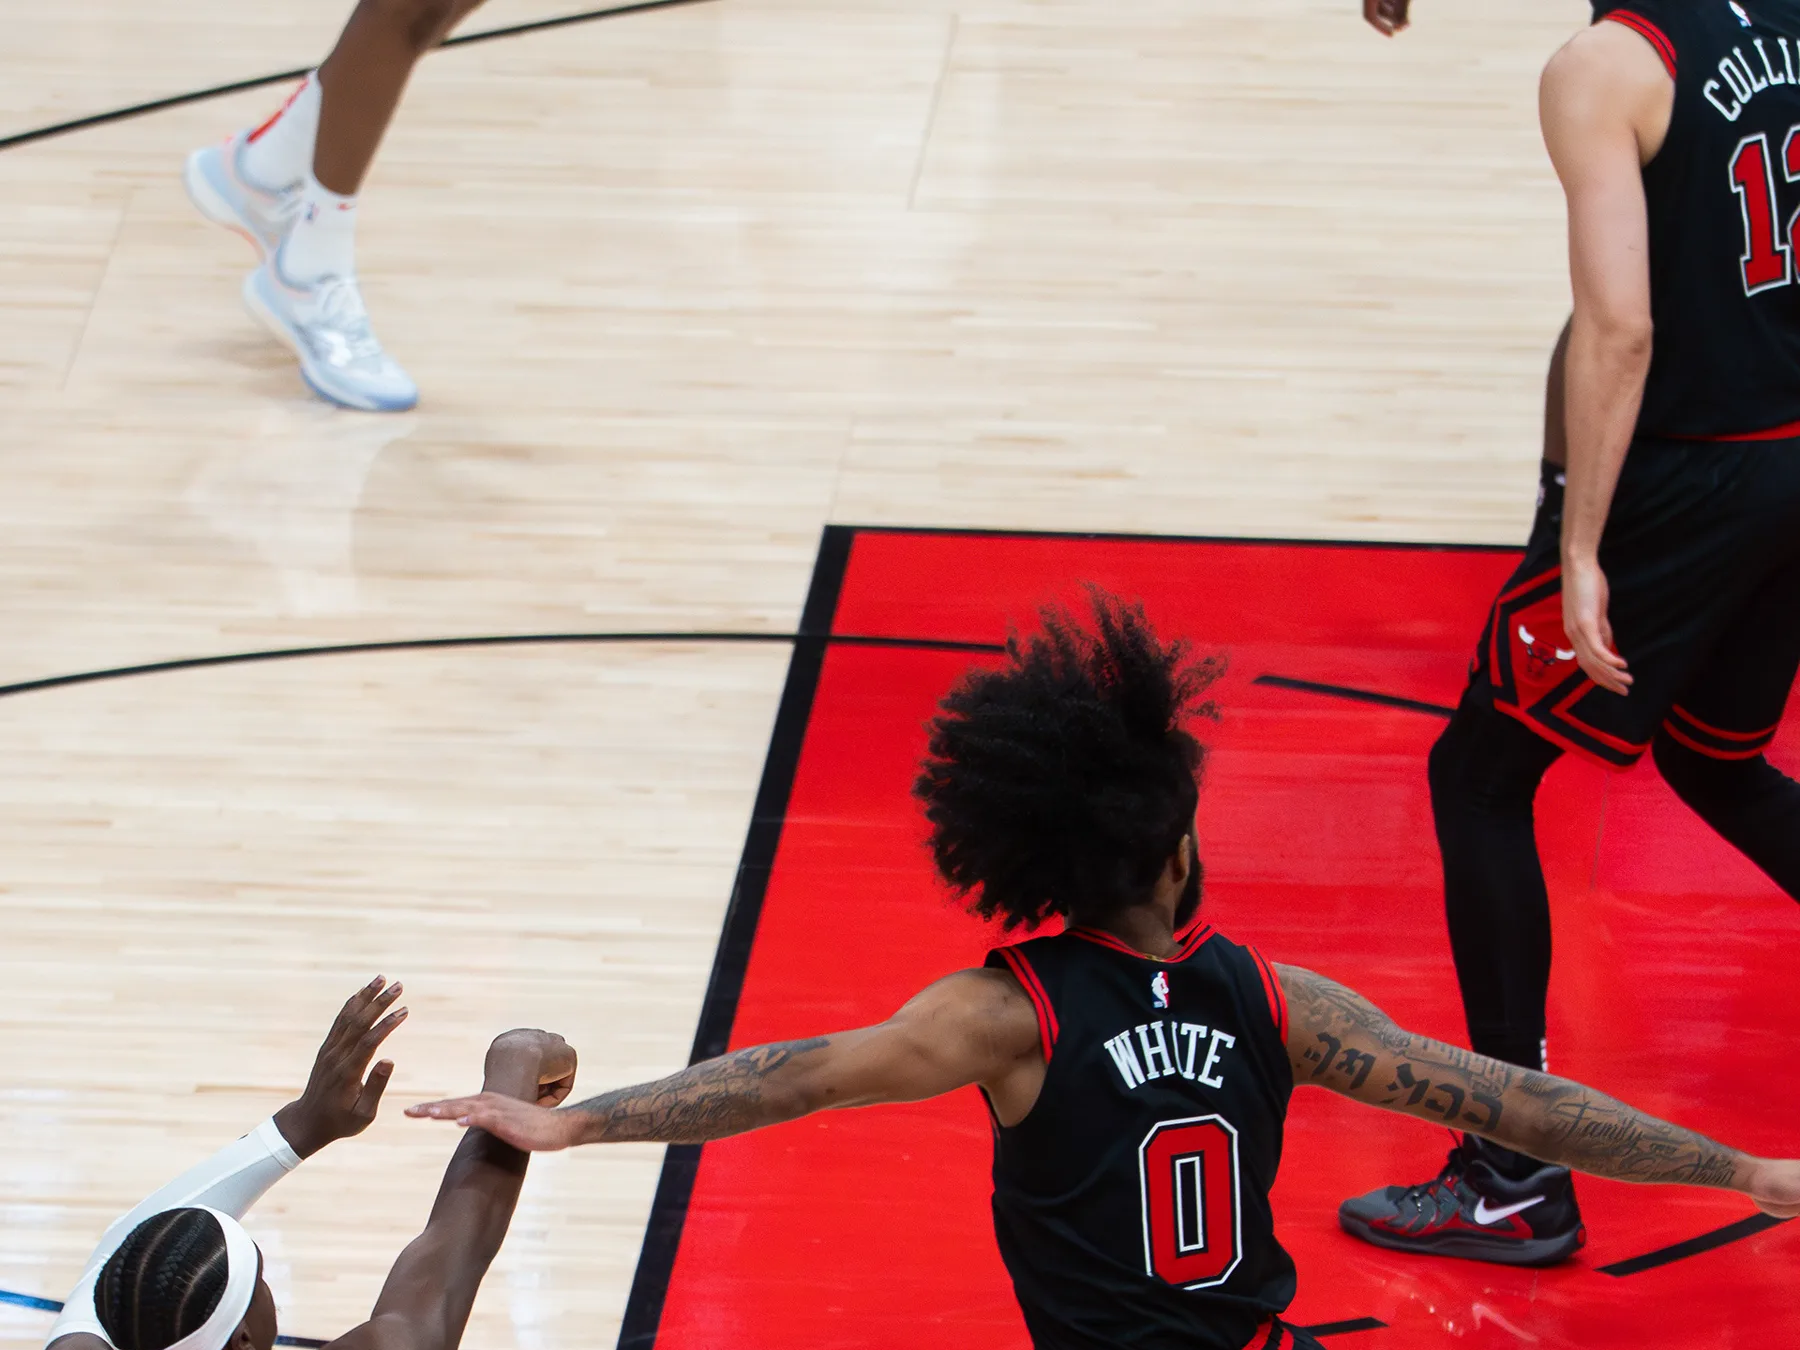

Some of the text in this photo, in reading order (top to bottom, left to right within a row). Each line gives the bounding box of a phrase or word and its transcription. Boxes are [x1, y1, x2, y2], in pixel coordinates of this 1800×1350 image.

[1703, 36, 1800, 121] COLLI
[1103, 1020, 1236, 1090] WHITE
[1139, 1113, 1242, 1291] 0
